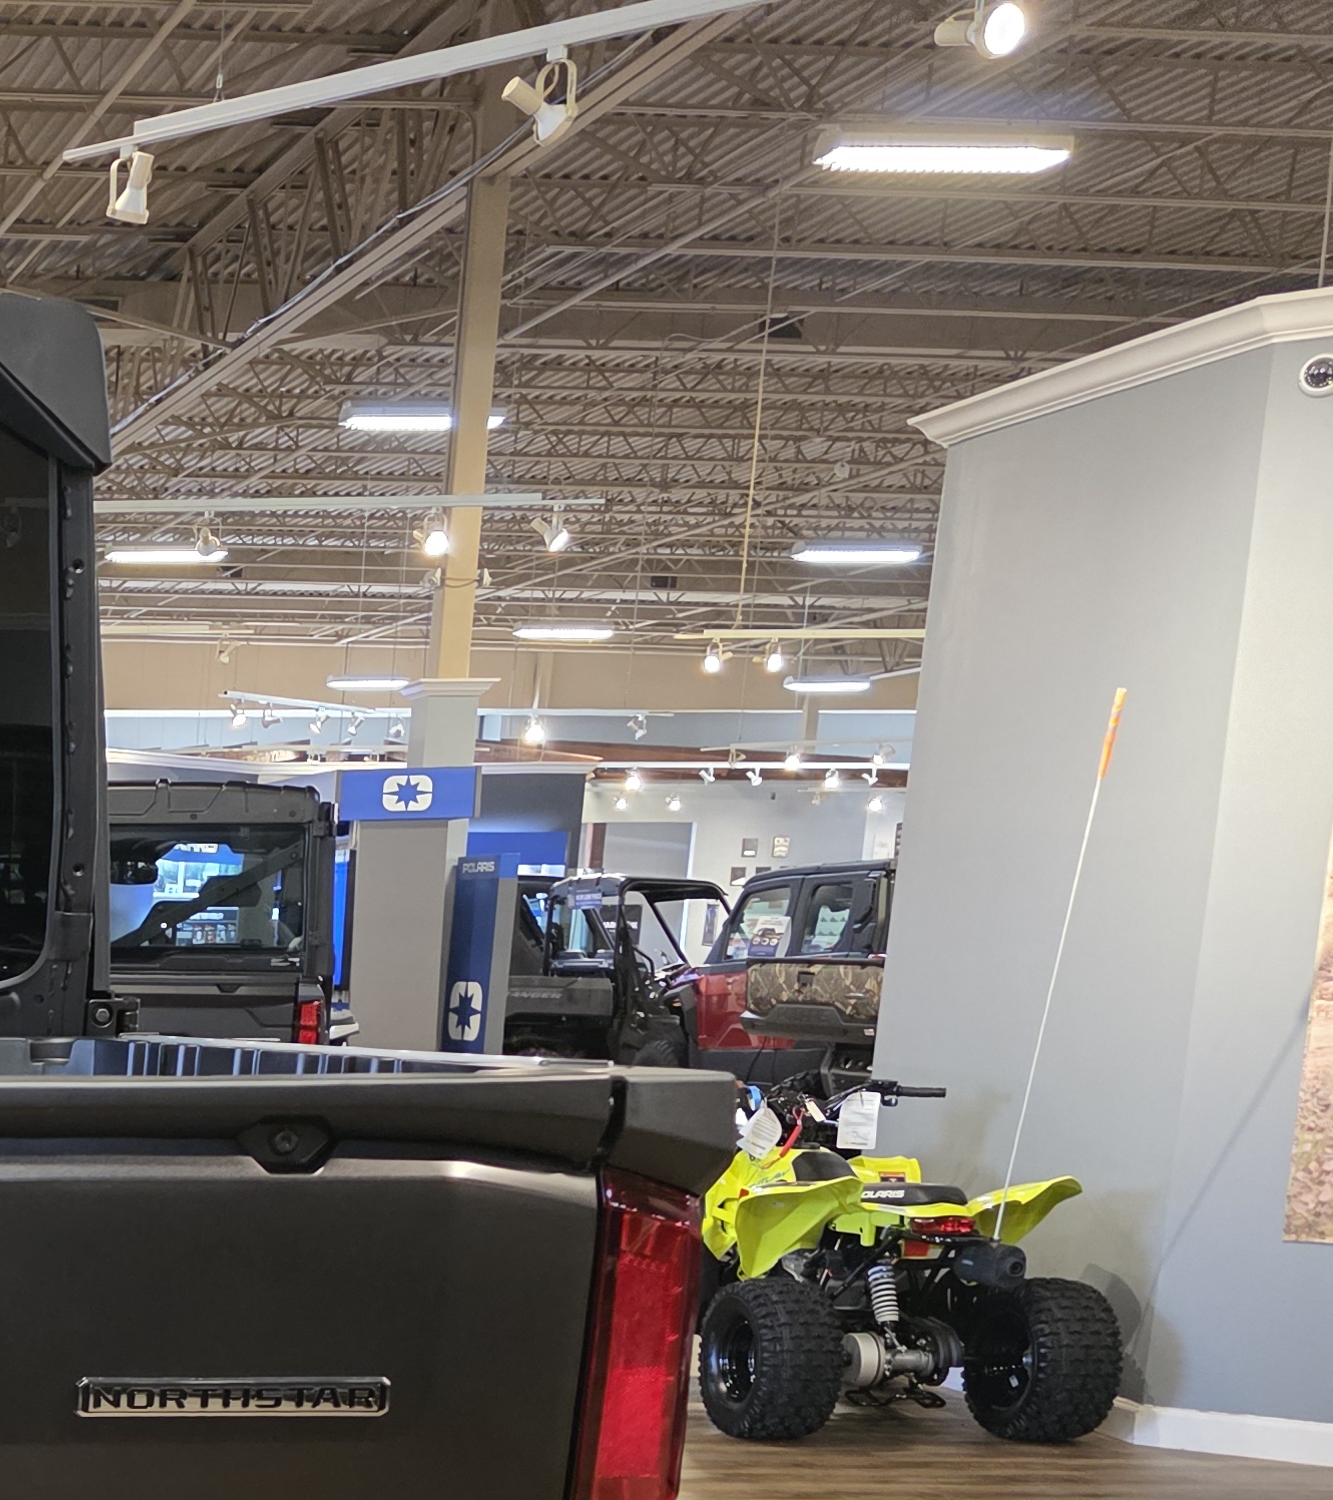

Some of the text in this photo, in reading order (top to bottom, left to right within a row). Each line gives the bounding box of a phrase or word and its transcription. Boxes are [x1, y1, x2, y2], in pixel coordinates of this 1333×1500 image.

[462, 861, 496, 874] POLARIS
[507, 991, 563, 999] ANGER
[861, 1189, 905, 1199] OLARIS
[91, 1386, 378, 1410] NORTHSTAR
